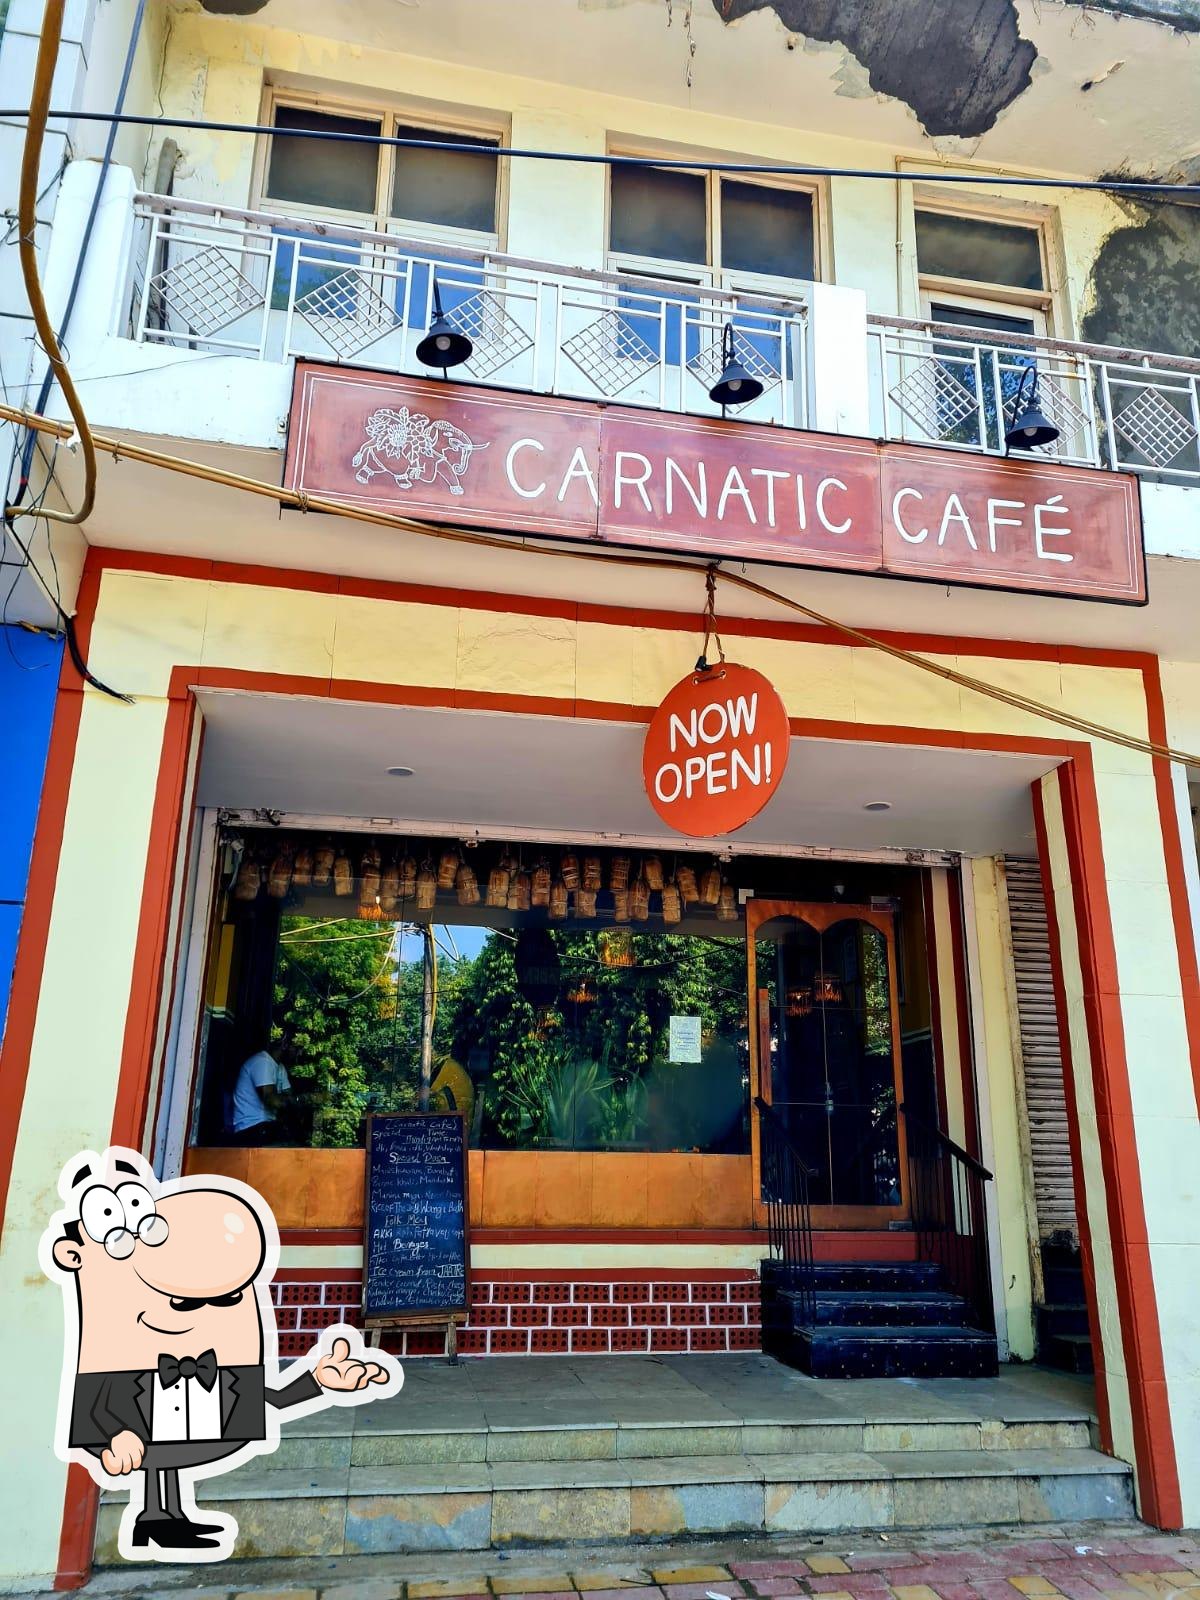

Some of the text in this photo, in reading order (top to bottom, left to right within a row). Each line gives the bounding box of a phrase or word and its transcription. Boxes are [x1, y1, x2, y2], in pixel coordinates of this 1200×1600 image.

[505, 438, 1074, 562] CARNATIC CAFÉ
[670, 693, 758, 753] NOW
[655, 742, 771, 803] OPEN!
